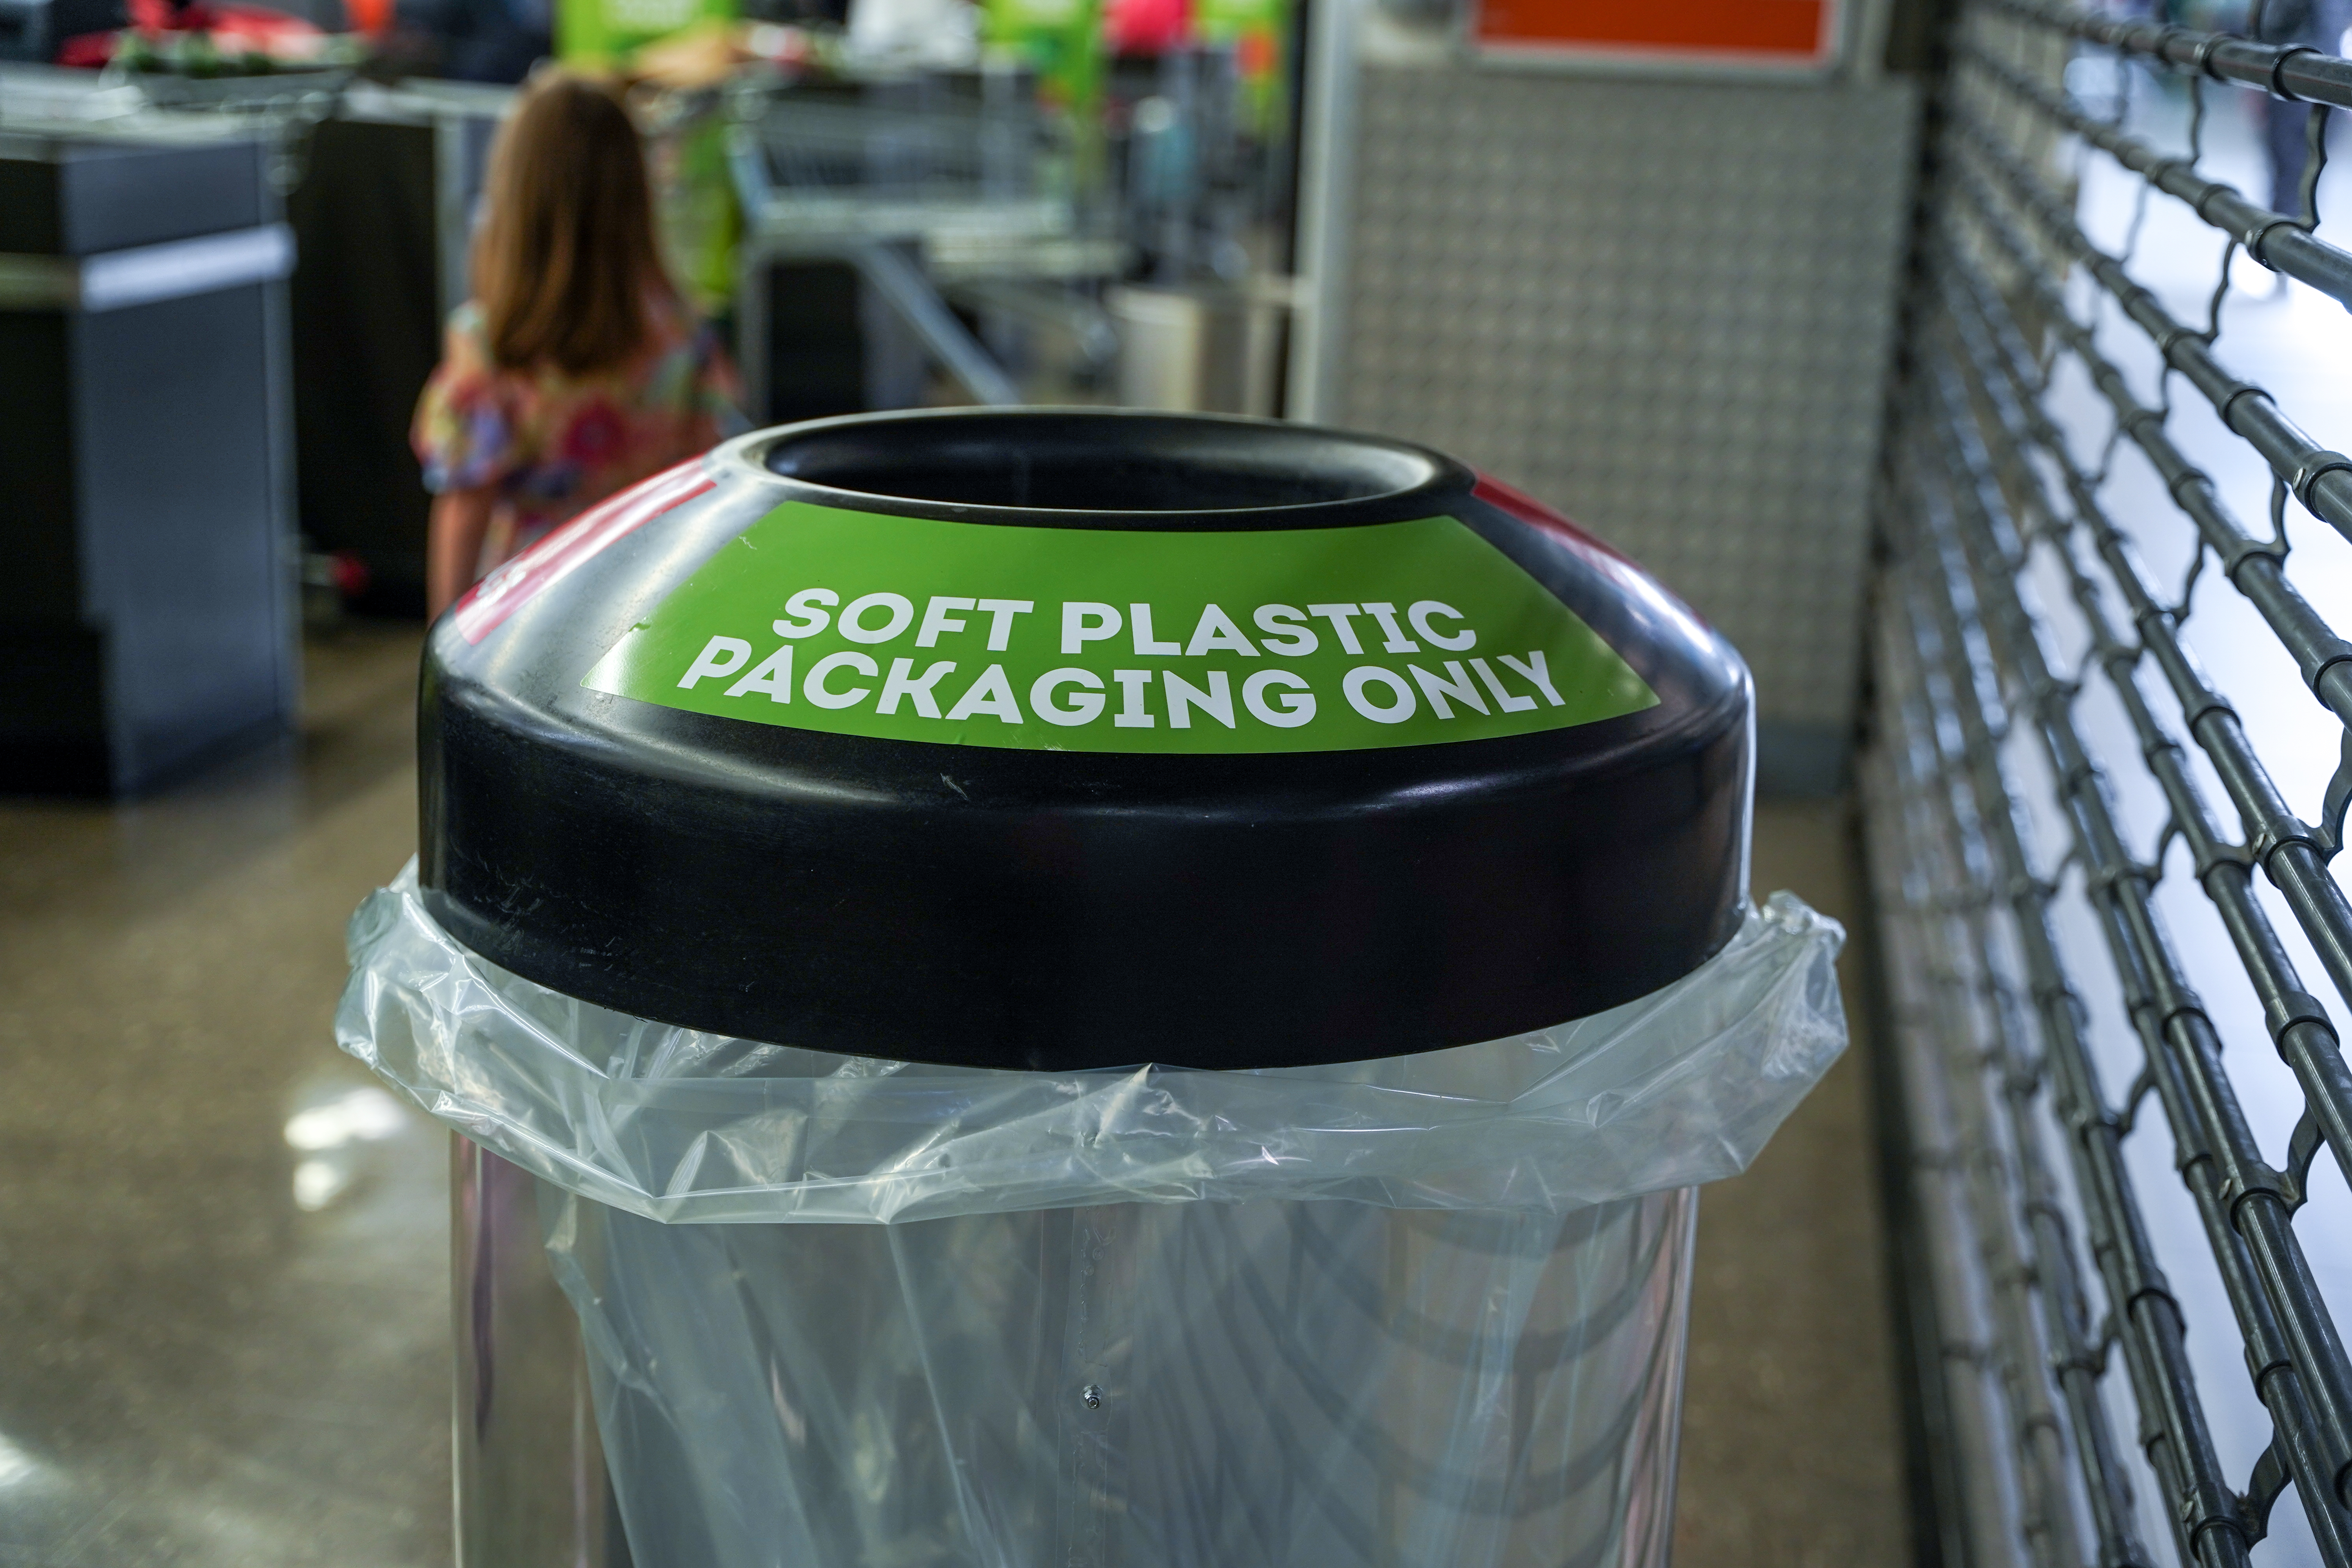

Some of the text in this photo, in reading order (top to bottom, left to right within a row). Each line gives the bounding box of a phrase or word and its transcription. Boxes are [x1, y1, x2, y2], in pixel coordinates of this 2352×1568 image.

[773, 588, 1476, 656] SOFT PLASTIC
[677, 635, 1565, 728] PACKAGING ONLY
